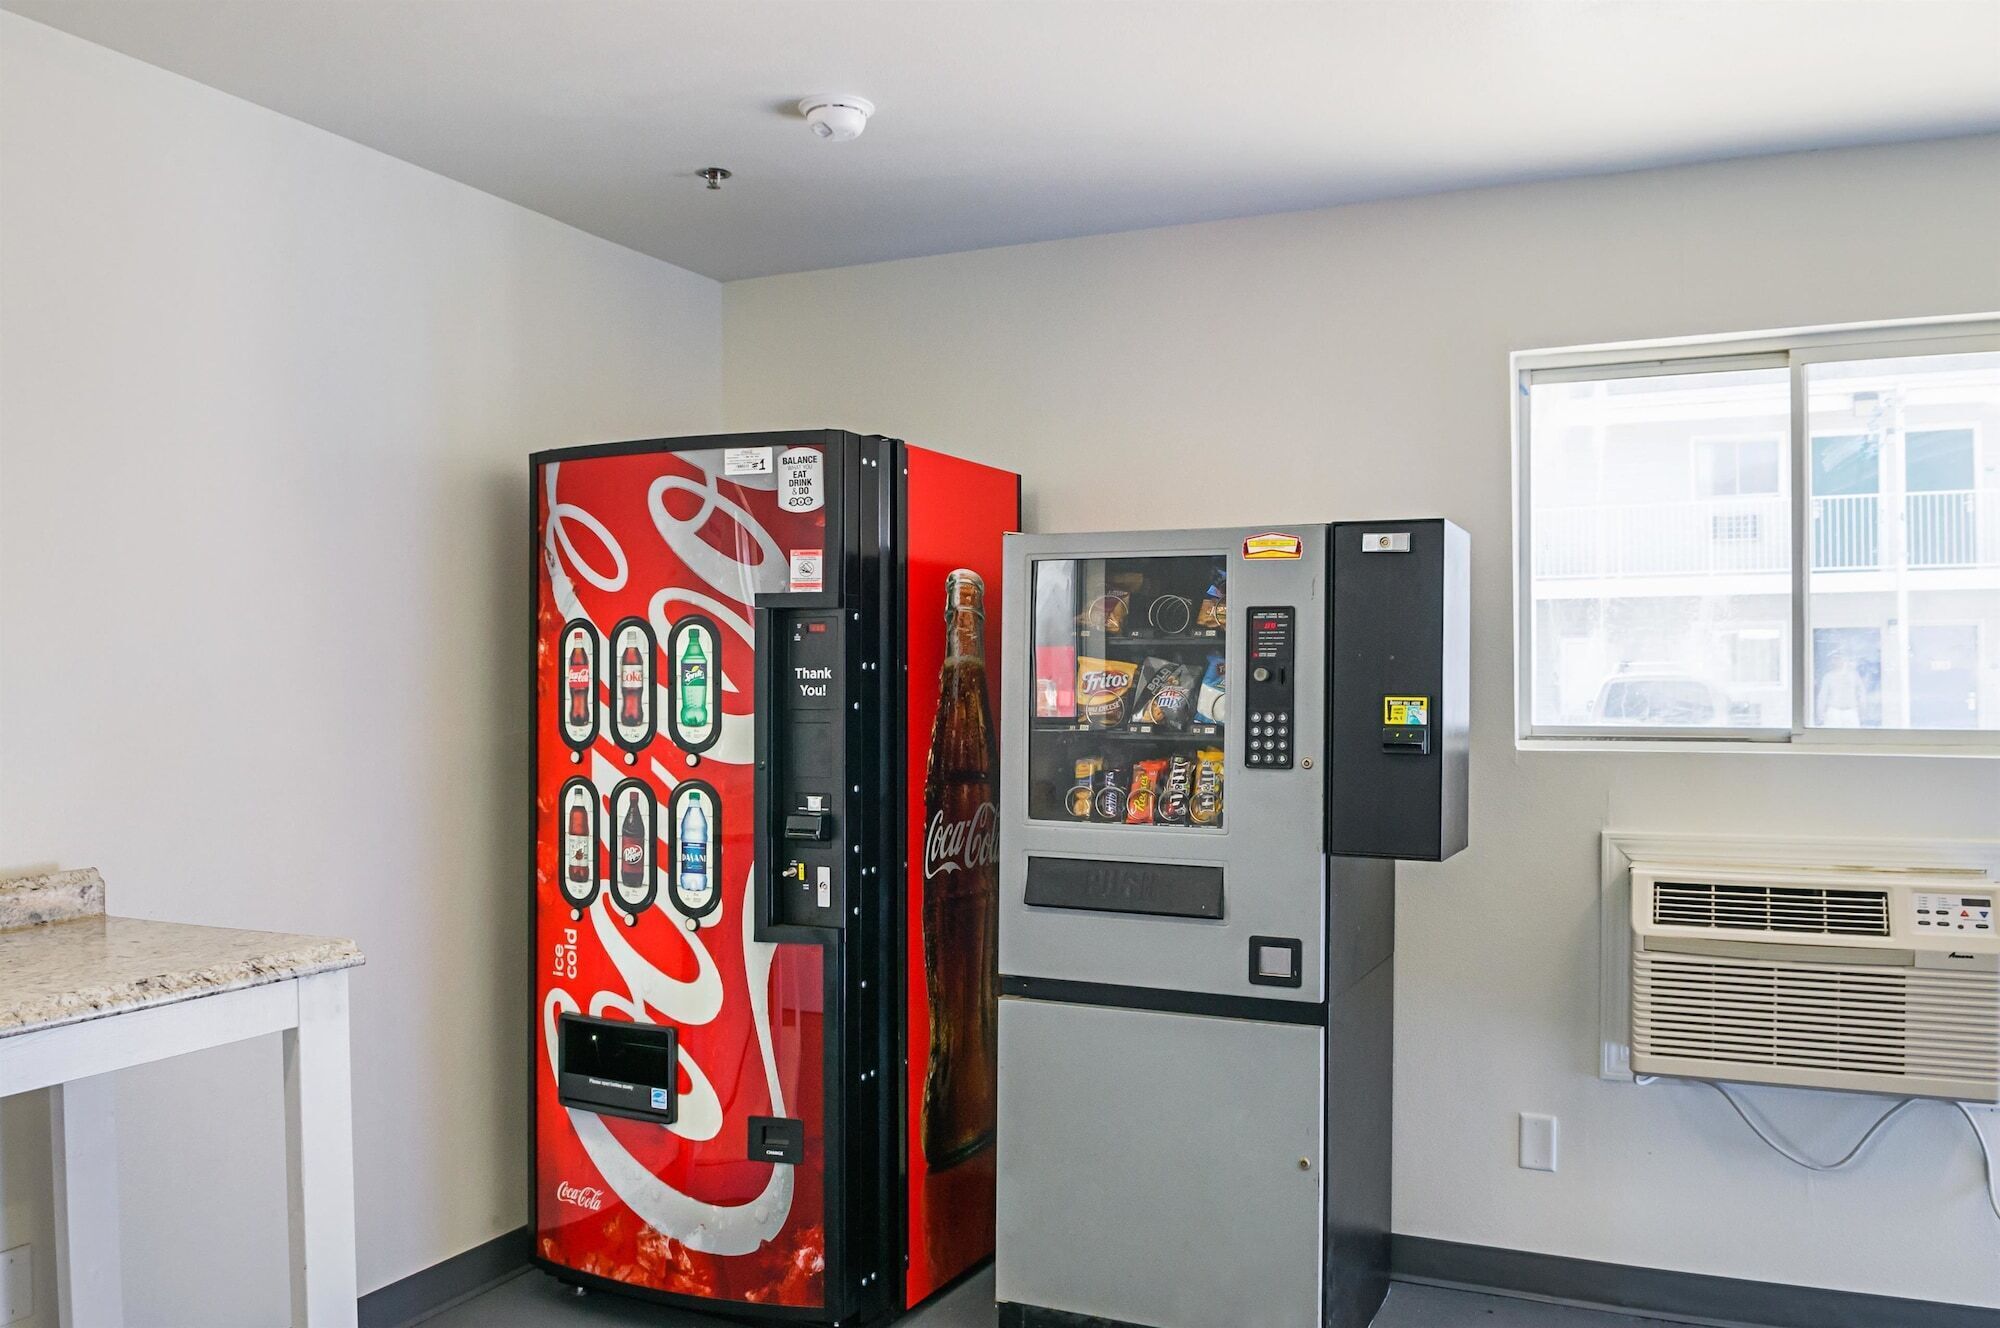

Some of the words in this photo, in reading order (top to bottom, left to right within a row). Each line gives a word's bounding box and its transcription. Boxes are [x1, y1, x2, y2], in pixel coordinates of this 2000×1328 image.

[782, 455, 818, 465] BALANCE
[793, 470, 807, 479] EAT
[789, 478, 812, 487] DRINK
[798, 487, 809, 495] DO
[794, 666, 832, 680] Thank
[1082, 671, 1129, 693] Fritos
[800, 684, 827, 697] You!
[564, 928, 577, 979] cold
[552, 944, 564, 977] ice
[557, 1181, 604, 1211] Coca-Cola
